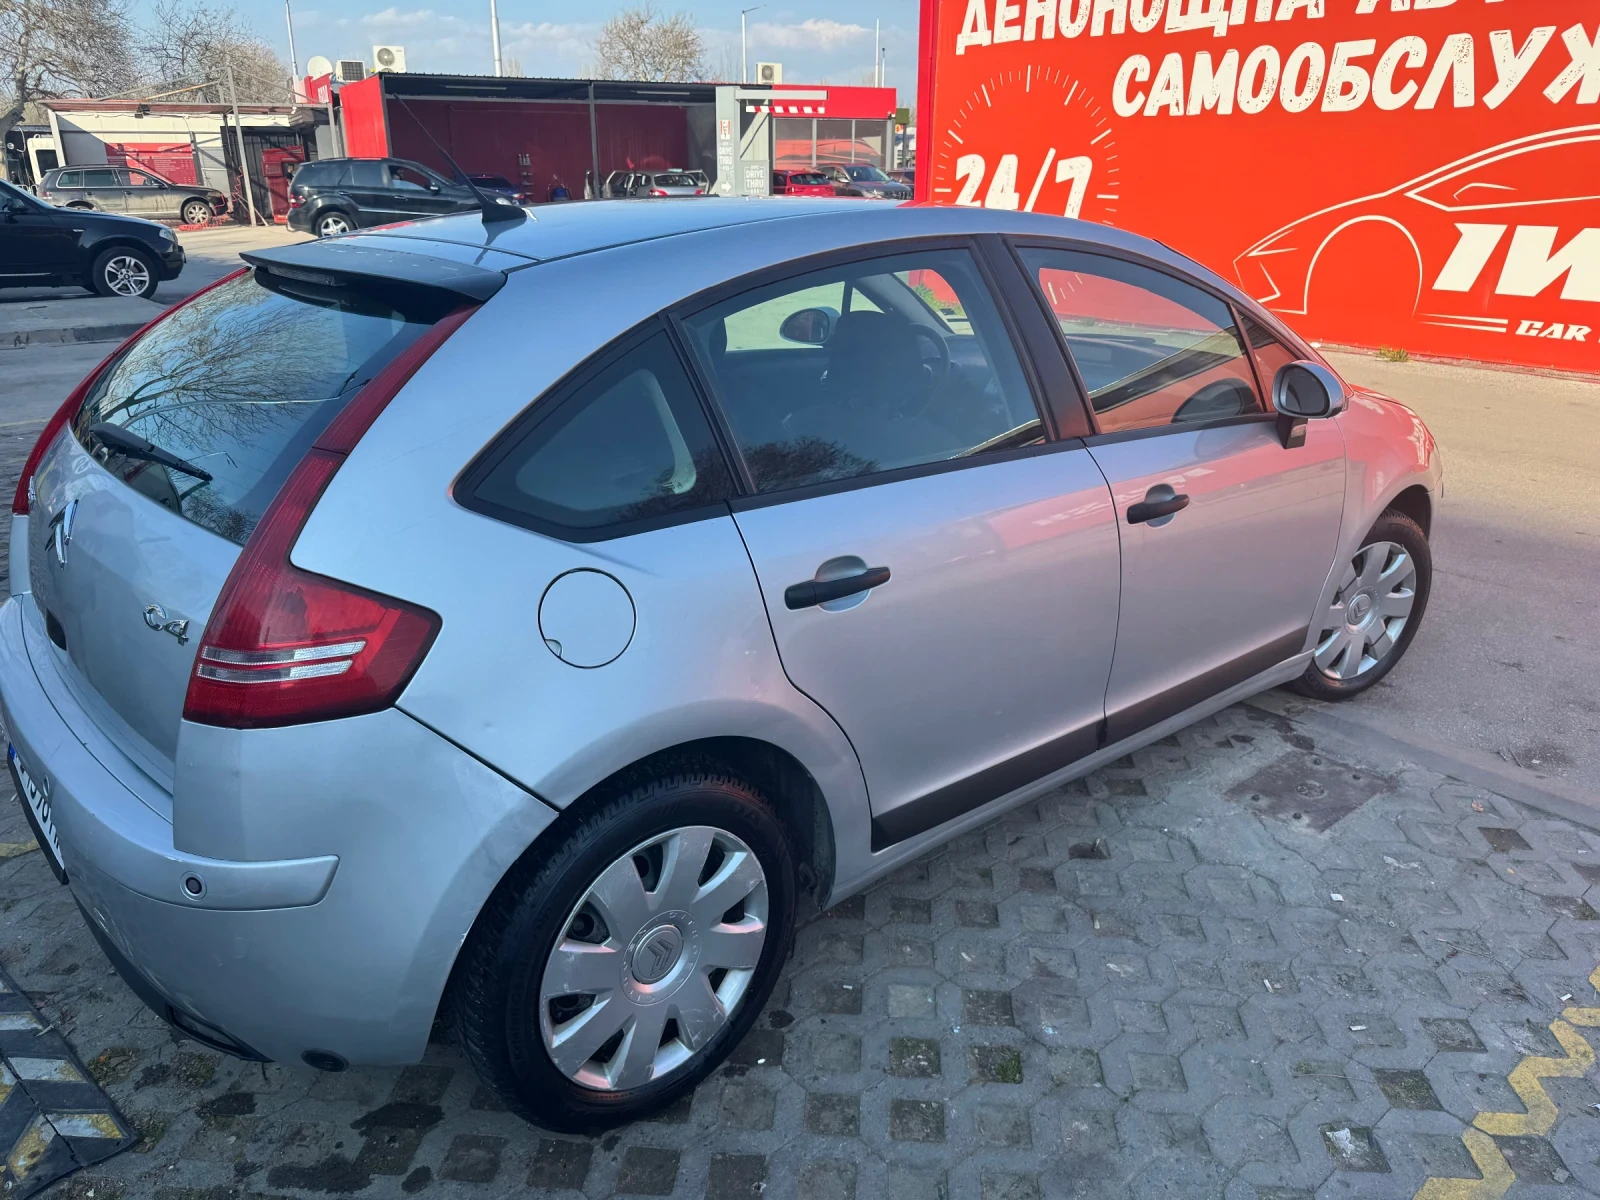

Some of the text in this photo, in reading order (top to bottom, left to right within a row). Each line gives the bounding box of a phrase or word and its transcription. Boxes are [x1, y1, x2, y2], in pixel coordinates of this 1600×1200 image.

[745, 169, 764, 178] DRIVE
[745, 179, 764, 188] THRU
[955, 147, 1093, 219] 24/7
[1515, 319, 1592, 342] CAR
[143, 604, 189, 646] C4
